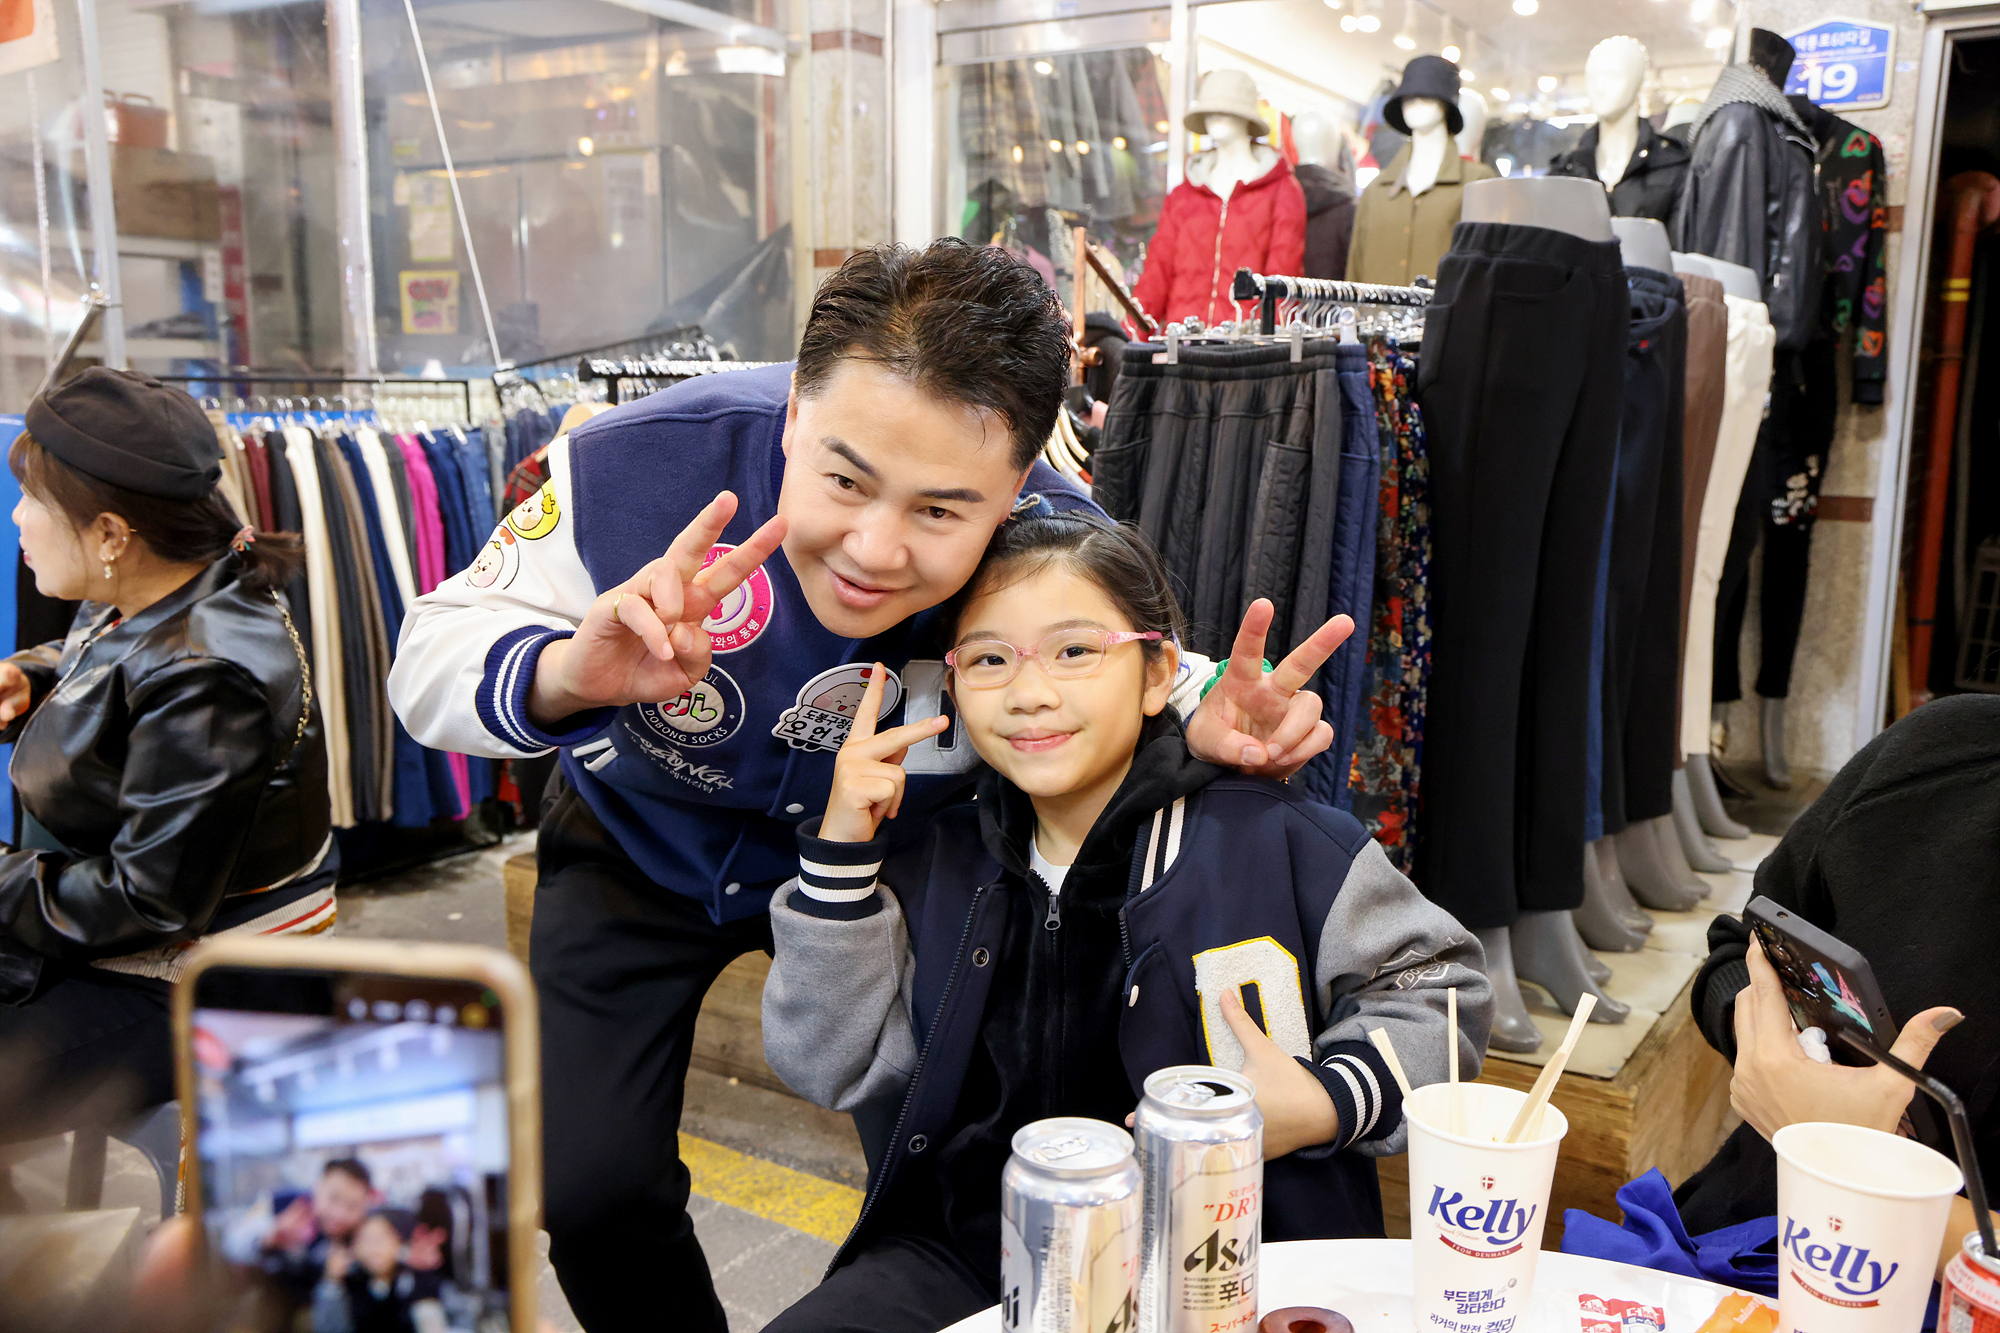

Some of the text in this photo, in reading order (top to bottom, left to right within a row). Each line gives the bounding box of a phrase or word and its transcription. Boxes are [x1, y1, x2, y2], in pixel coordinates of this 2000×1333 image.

[1796, 63, 1858, 100] 19
[739, 619, 760, 639] 동행
[645, 710, 728, 744] DOBONG SOCKS
[1428, 1184, 1537, 1246] Kelly
[1452, 1243, 1511, 1258] FROM DENMARK
[1783, 1215, 1899, 1296] Kelly
[1218, 1273, 1254, 1302] 辛口
[1443, 1288, 1493, 1302] 부드럽게
[1456, 1297, 1506, 1314] 강타한다
[1430, 1313, 1458, 1332] 라거의
